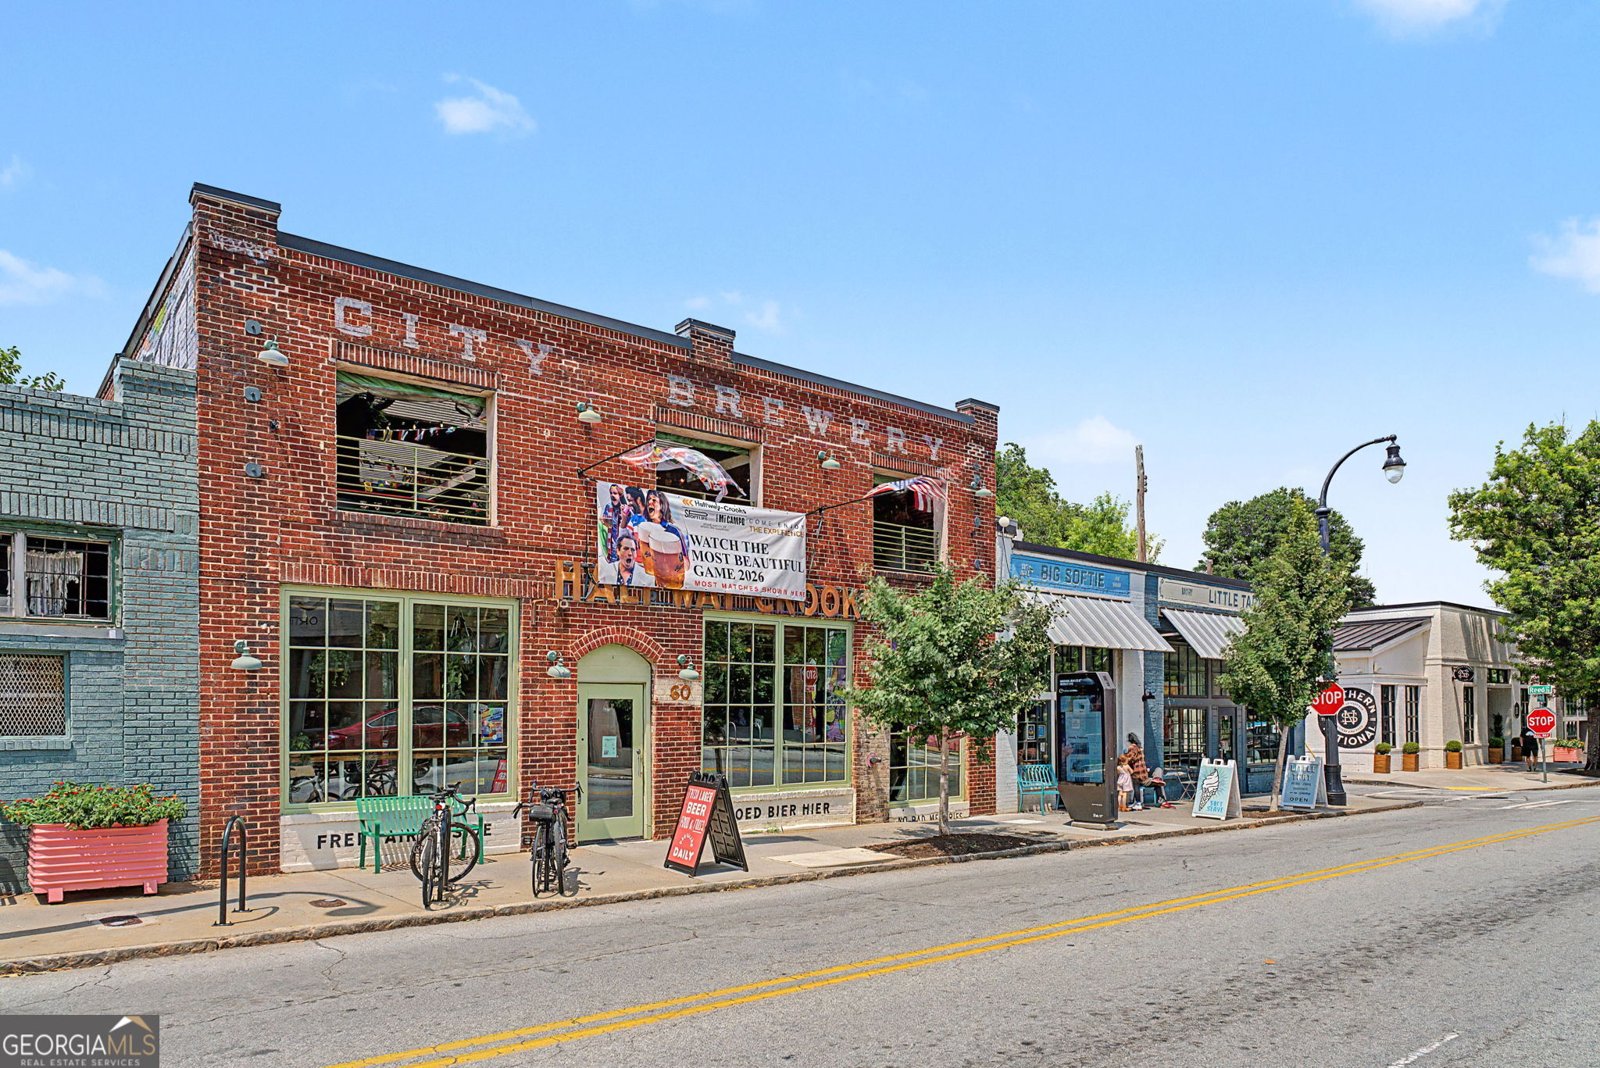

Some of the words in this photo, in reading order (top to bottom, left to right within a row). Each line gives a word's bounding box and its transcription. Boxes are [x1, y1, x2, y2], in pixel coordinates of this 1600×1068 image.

[334, 297, 553, 376] CITY
[667, 375, 943, 461] BREWERY
[749, 525, 763, 534] THE
[690, 533, 739, 551] WATCH
[741, 541, 769, 555] THE
[691, 549, 731, 565] MOST
[735, 554, 805, 573] BEAUTIFUL
[693, 564, 736, 580] GAME
[737, 569, 765, 583] 2026
[1041, 565, 1060, 582] BIG
[1064, 568, 1105, 588] SOFTIE
[694, 580, 717, 588] MOST
[721, 582, 759, 592] MATCHES
[1208, 589, 1239, 607] LITTLE
[1241, 594, 1259, 609] TA
[670, 684, 691, 701] 60
[1529, 686, 1545, 694] Reed
[1344, 689, 1376, 713] HERN
[1528, 716, 1554, 727] STOP
[1337, 726, 1376, 745] TIONAL
[686, 801, 707, 817] BEER
[735, 807, 762, 820] OED
[767, 804, 797, 818] BIER
[802, 802, 831, 816] HIER
[672, 846, 694, 861] DAILY
